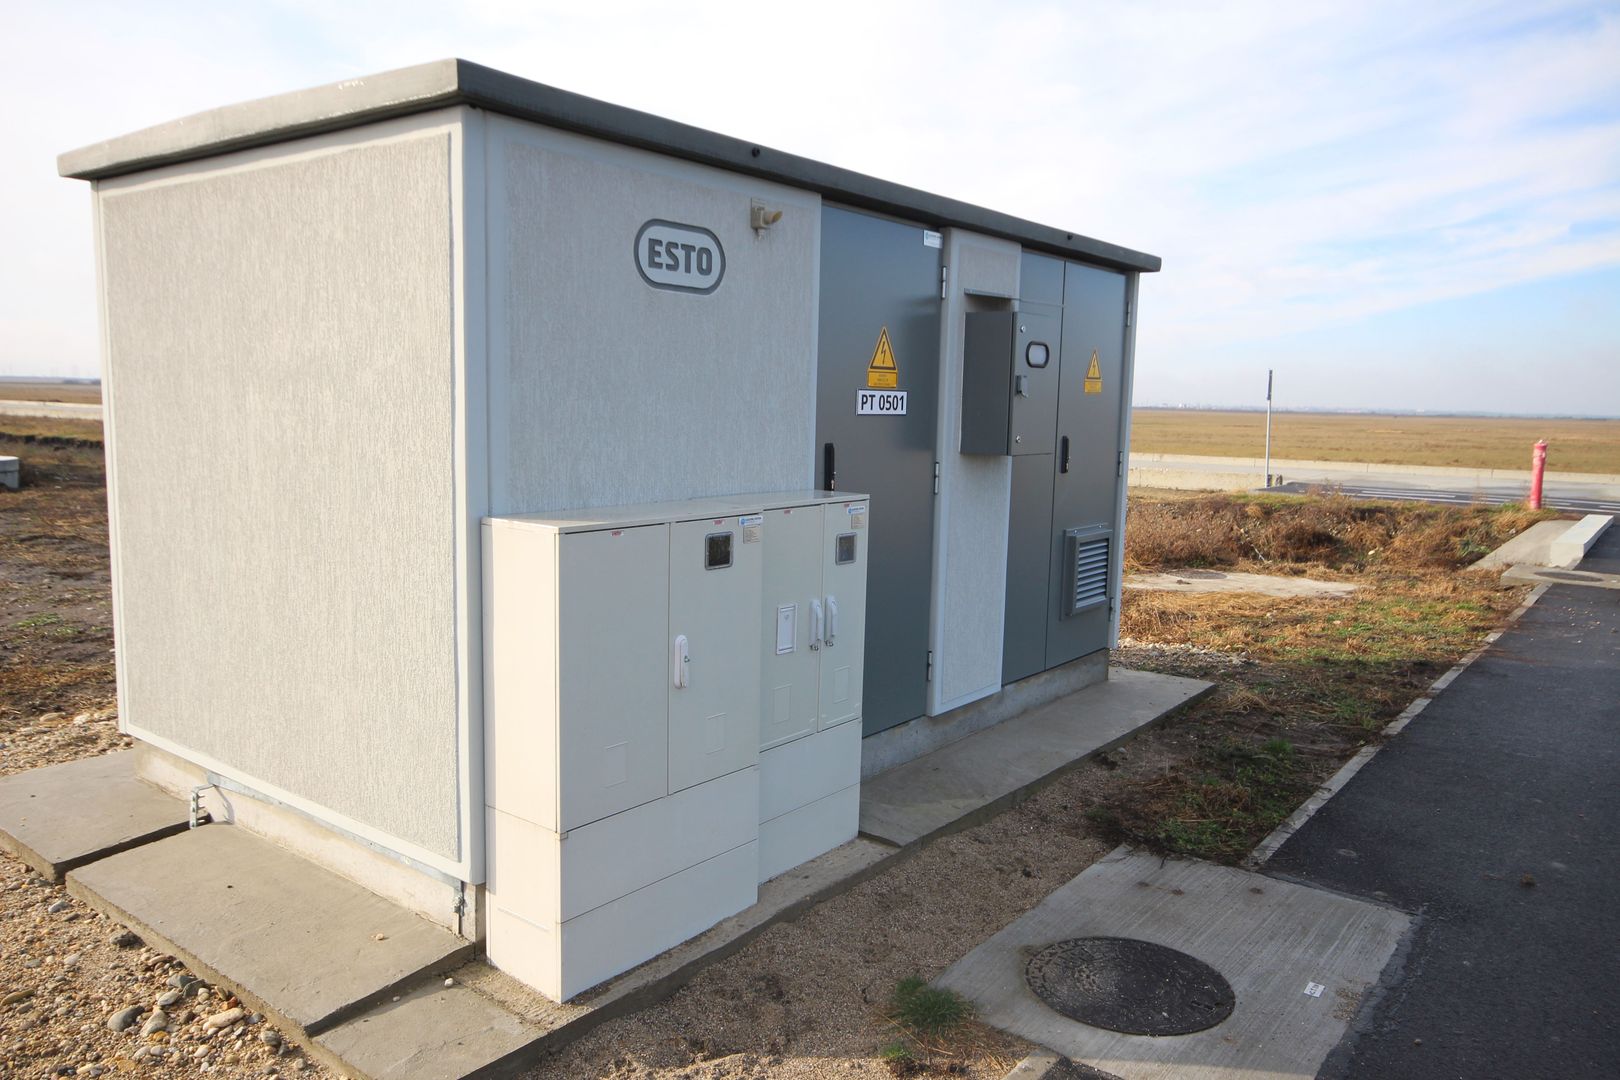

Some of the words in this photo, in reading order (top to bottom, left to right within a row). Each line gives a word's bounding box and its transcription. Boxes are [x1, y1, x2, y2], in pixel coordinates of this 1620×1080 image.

[647, 237, 713, 276] ESTO
[861, 394, 876, 411] PT
[878, 394, 905, 412] 0501
